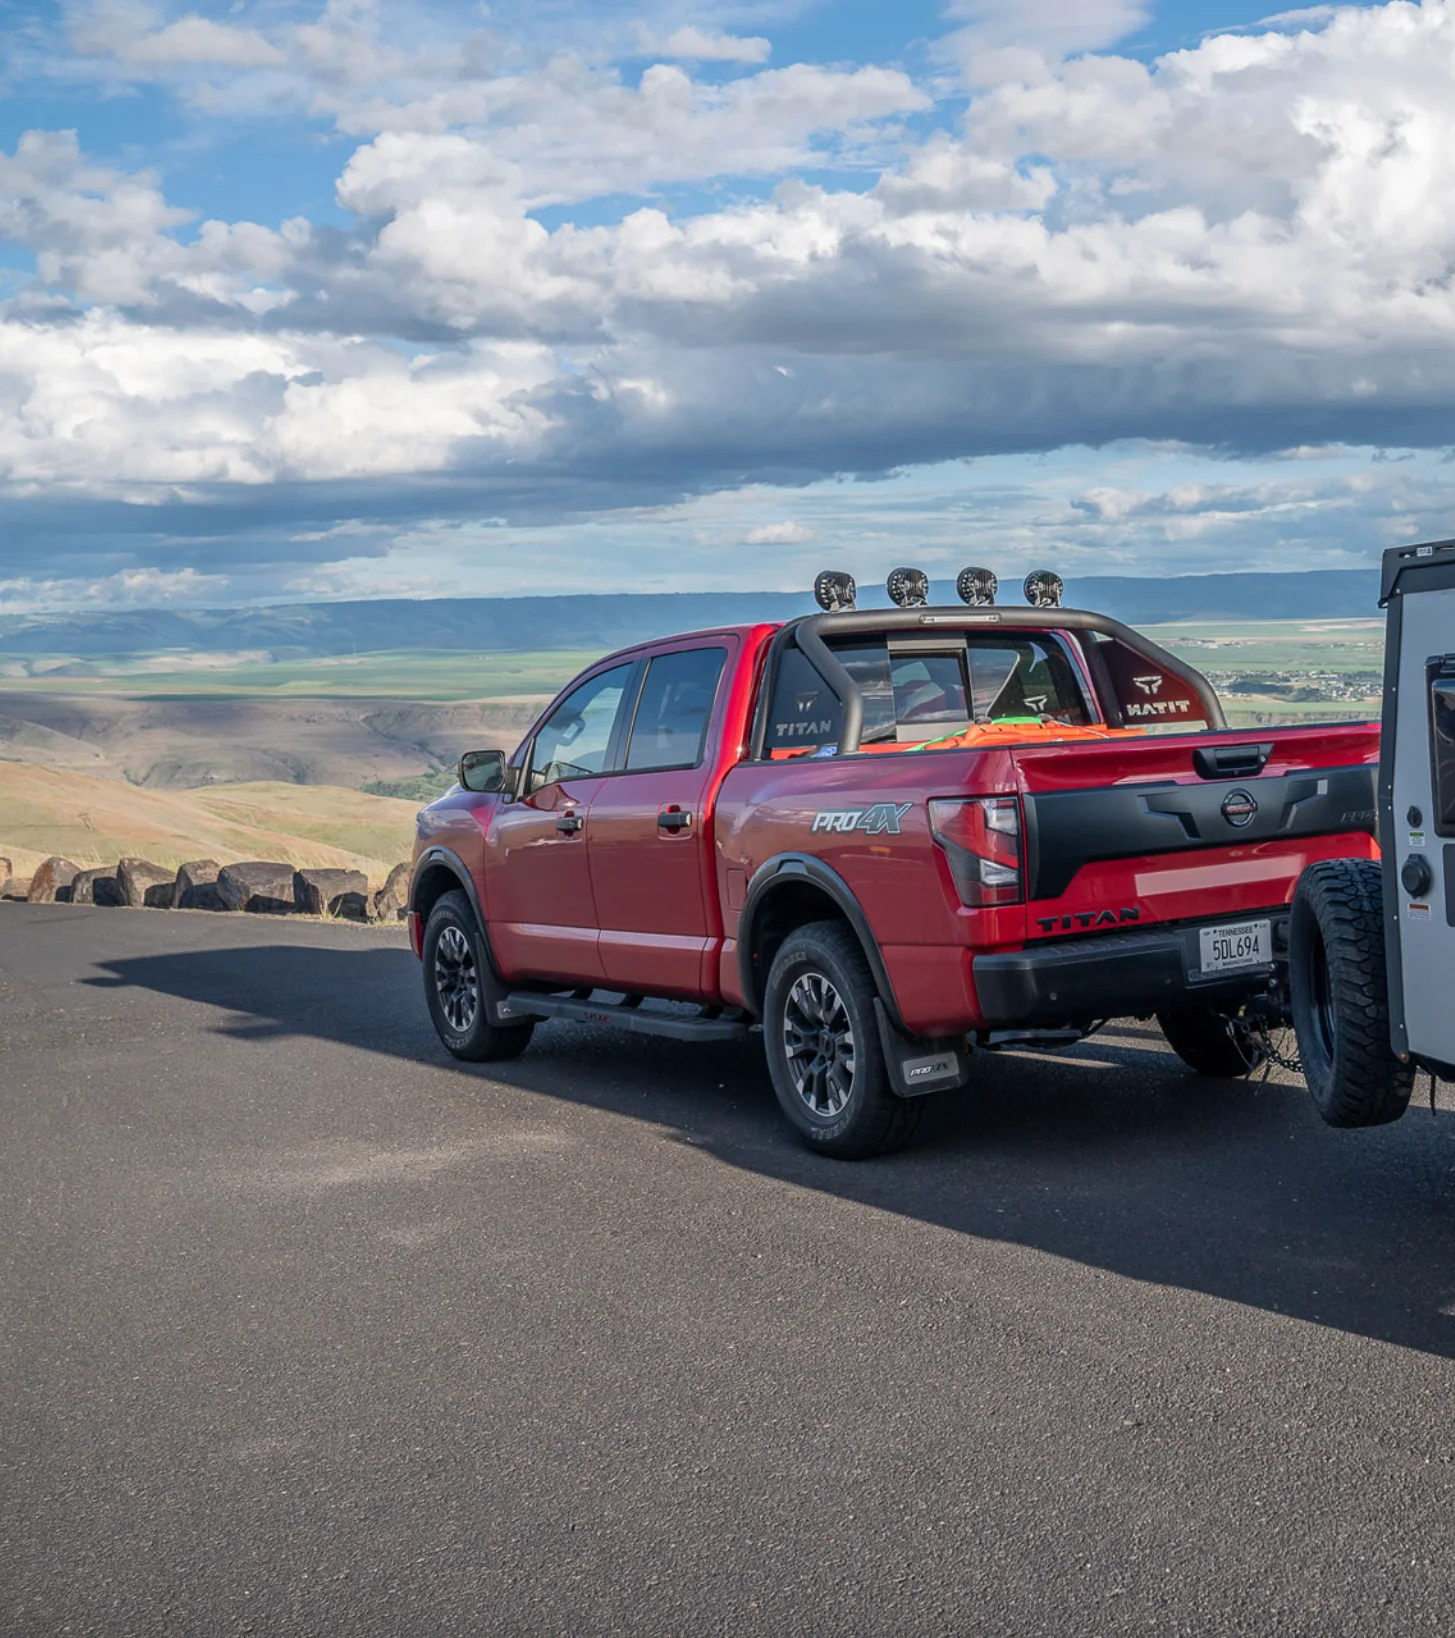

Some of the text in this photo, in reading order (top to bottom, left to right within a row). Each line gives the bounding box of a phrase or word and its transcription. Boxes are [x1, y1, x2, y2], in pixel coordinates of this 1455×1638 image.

[775, 719, 832, 738] TITAN
[1037, 906, 1140, 932] TITAN
[1217, 926, 1254, 938] TENNESSEE
[1213, 935, 1260, 961] 5DL694
